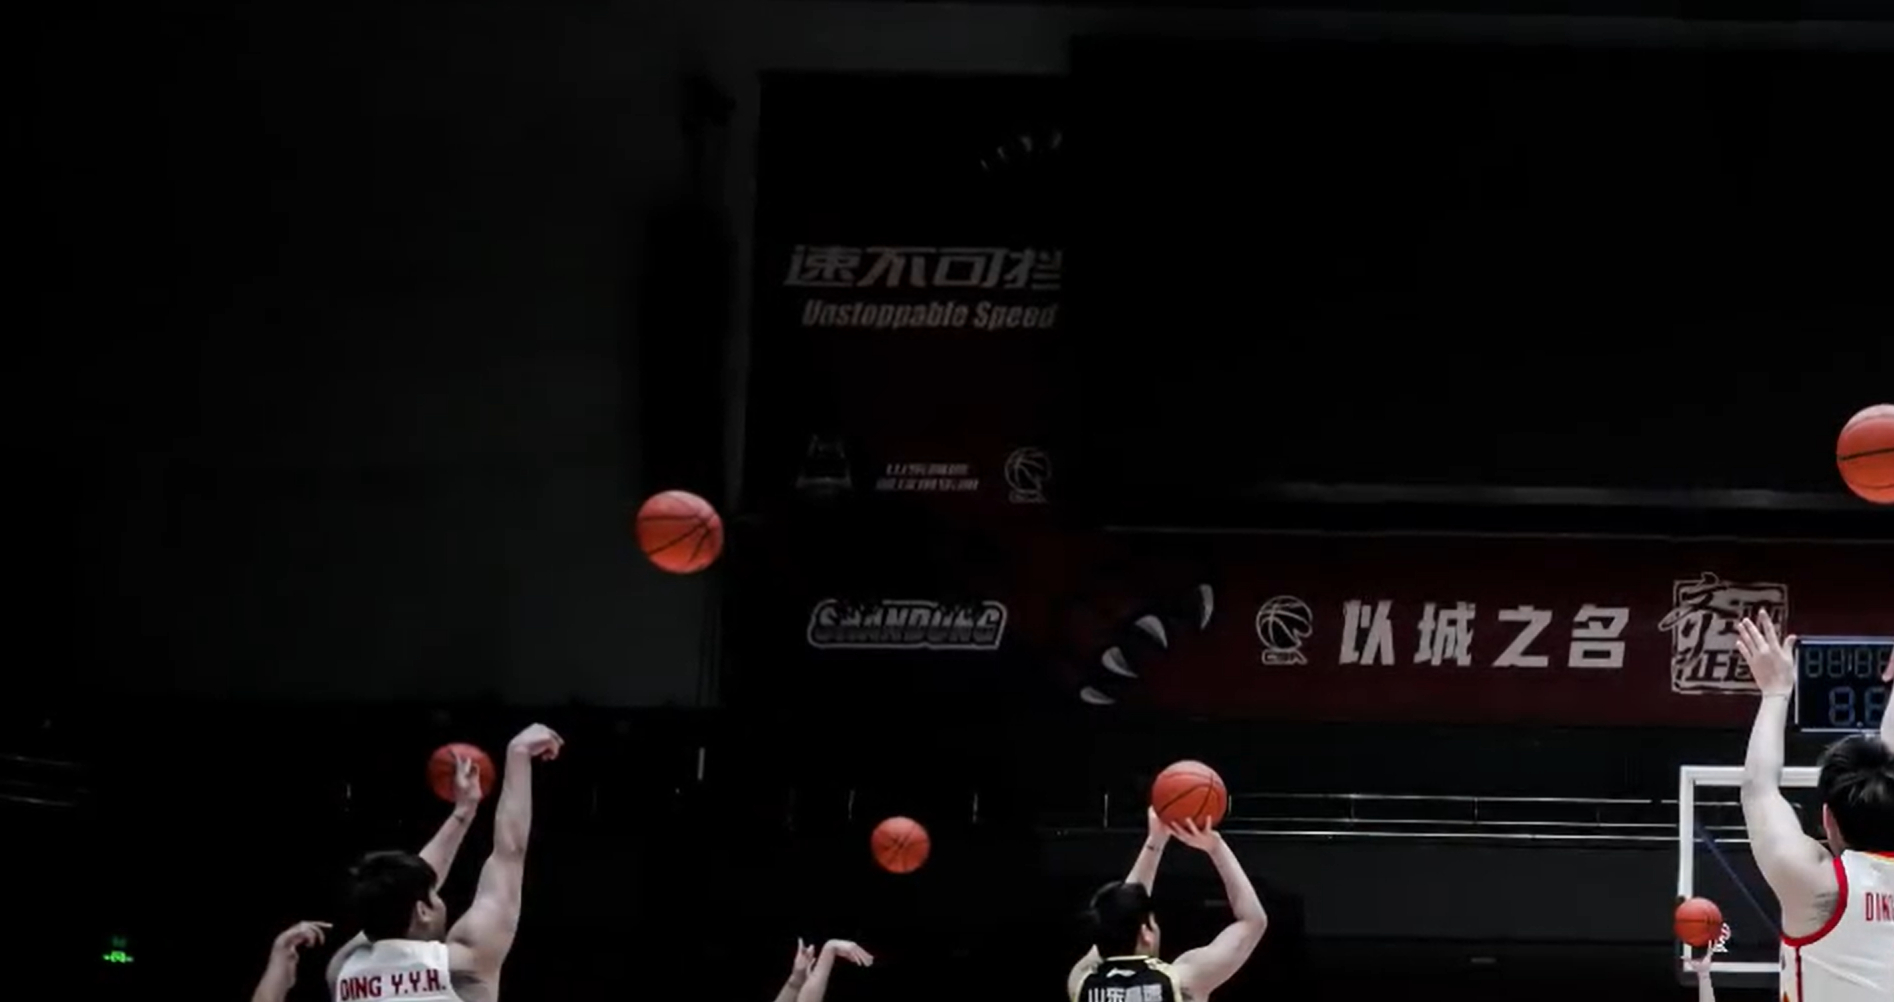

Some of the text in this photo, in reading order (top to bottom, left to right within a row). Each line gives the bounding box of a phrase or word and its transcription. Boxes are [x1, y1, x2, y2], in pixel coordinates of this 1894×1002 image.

[801, 299, 1060, 331] Unstoppable Speed
[1338, 599, 1630, 669] 以城之名
[340, 968, 447, 1001] DING Y.Y.H.
